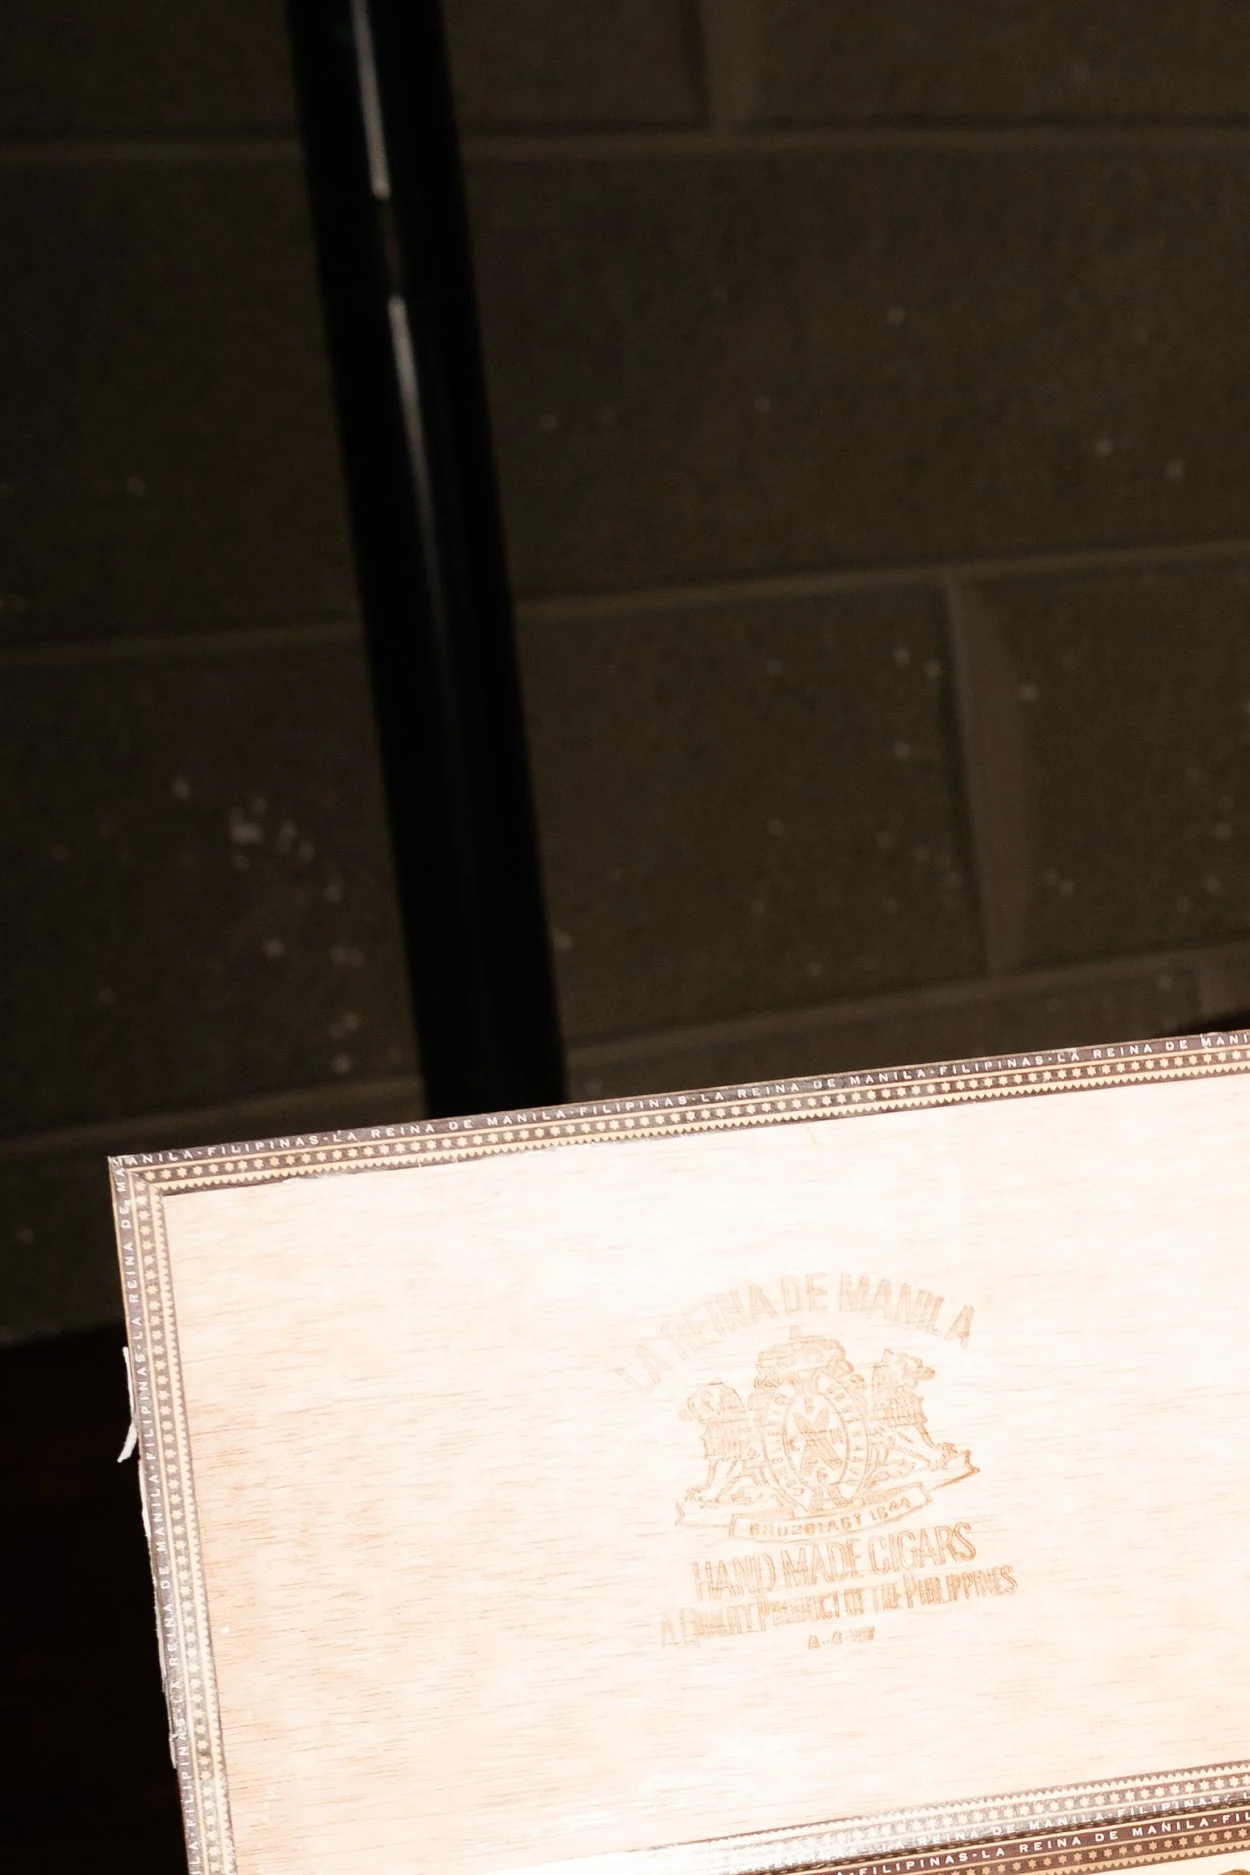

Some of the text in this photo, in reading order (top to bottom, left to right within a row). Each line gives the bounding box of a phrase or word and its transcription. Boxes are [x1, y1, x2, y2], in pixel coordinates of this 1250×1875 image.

[370, 1122, 435, 1140] REINA
[448, 1118, 473, 1131] DE
[737, 1082, 799, 1099] REINA
[813, 1078, 835, 1090] DE
[1092, 1042, 1152, 1059] REINA
[1165, 1038, 1188, 1052] DE
[119, 1205, 131, 1228] DE
[123, 1241, 138, 1303] REINA
[779, 1272, 831, 1312] DE
[838, 1272, 975, 1350] MANILA
[159, 1565, 172, 1588] DE
[692, 1521, 977, 1601] HAND MADE CIGARS
[163, 1602, 179, 1666] REINA
[1018, 1835, 1082, 1853] REINA
[1094, 1829, 1119, 1843] DE
